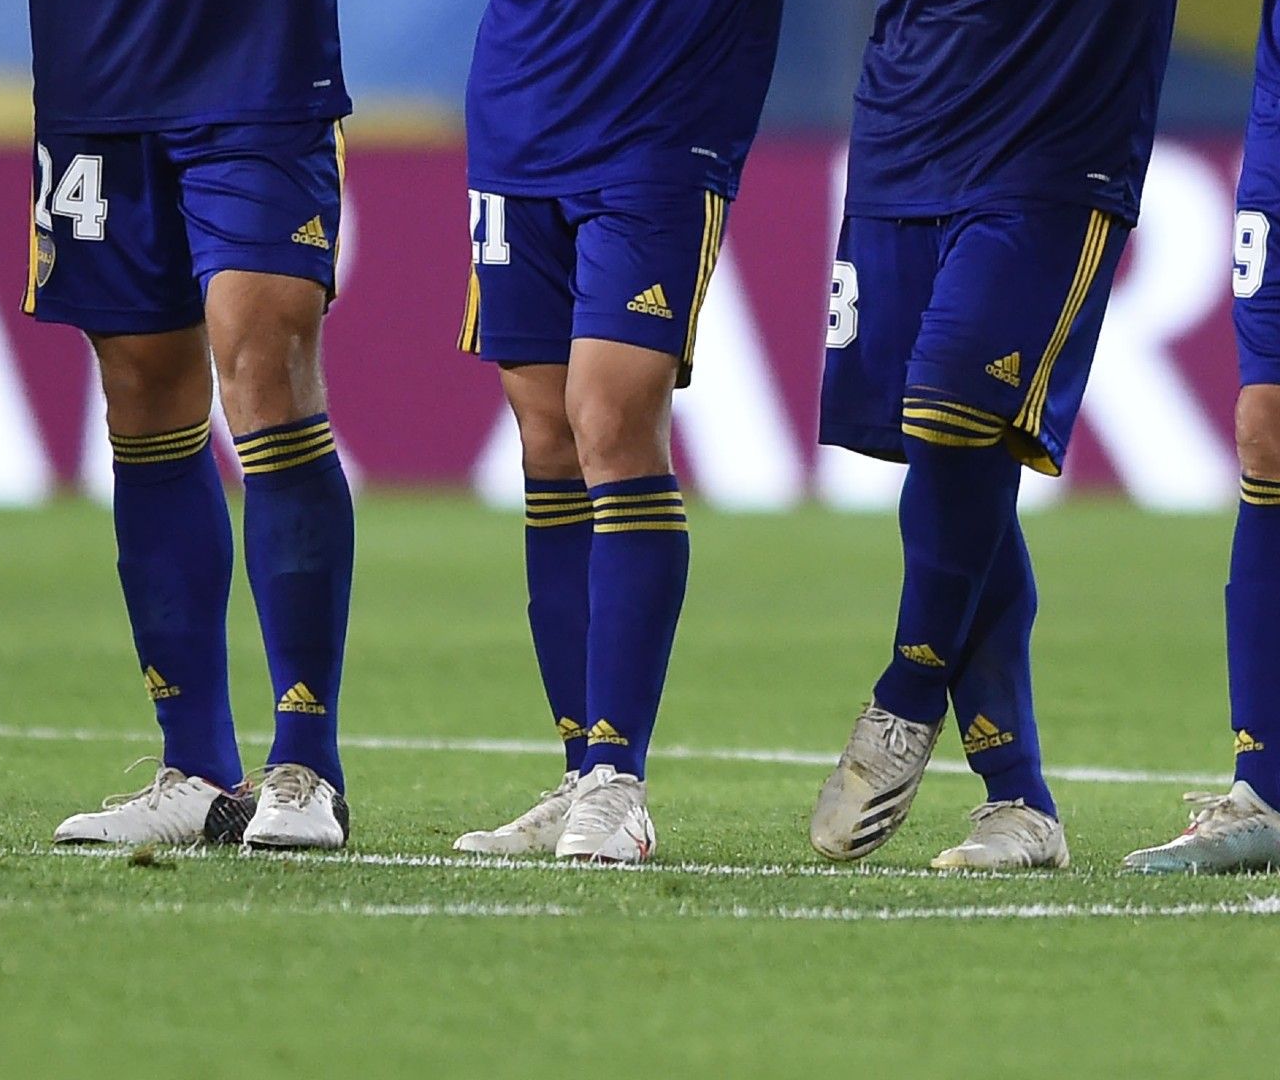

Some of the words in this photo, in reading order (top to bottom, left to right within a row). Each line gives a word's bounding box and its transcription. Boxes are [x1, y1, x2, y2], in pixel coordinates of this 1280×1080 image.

[291, 232, 330, 250] adidas
[1232, 210, 1270, 298] 9
[627, 300, 673, 319] adidas
[277, 701, 326, 716] adidas
